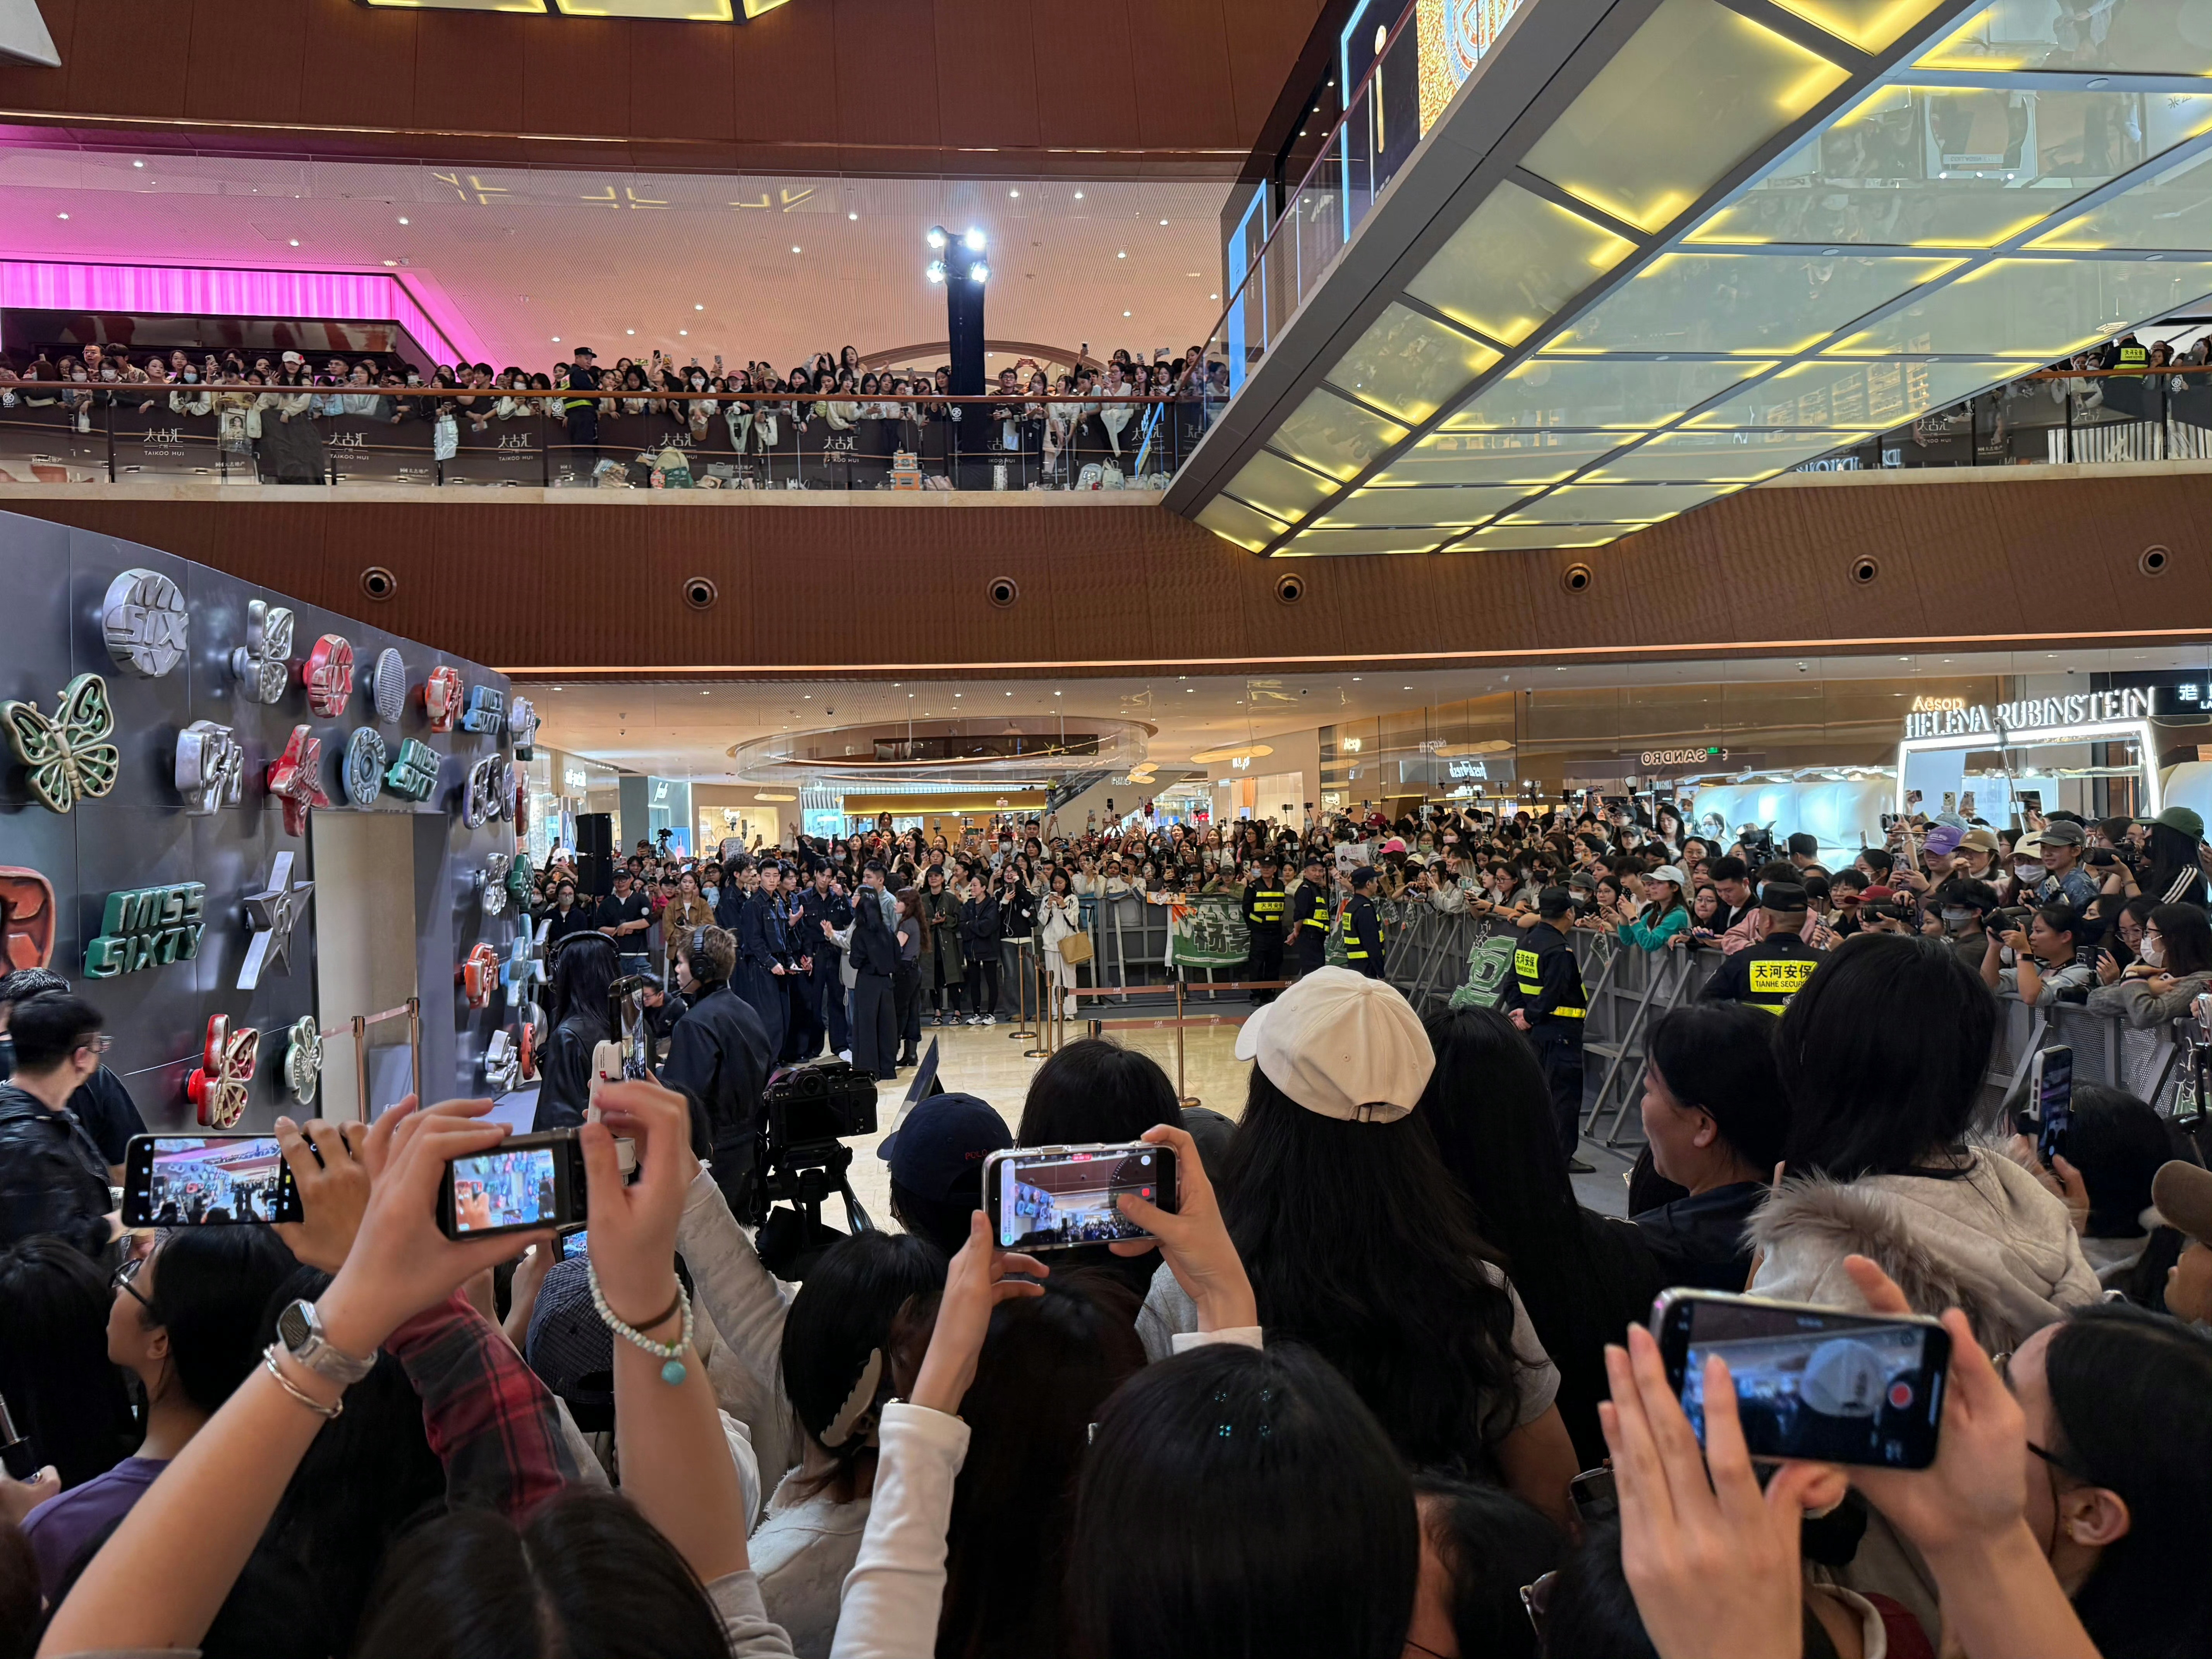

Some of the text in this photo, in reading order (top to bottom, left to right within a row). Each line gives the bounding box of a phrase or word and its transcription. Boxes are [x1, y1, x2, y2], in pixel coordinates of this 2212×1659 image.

[144, 428, 183, 443] 太古汇
[329, 432, 368, 447] 太古汇
[498, 433, 532, 448] 太古汇
[660, 433, 697, 447] 太古汇
[823, 436, 859, 450] 太古汇
[1905, 686, 2155, 739] HELENA RUBINSTEIN
[1912, 696, 1963, 714] Aesop
[404, 739, 442, 775] MISS
[392, 763, 438, 802] SIXTY
[118, 883, 206, 932] MISS
[91, 922, 206, 978] SIXTY
[1516, 953, 1535, 967] 天河安保
[1755, 965, 1812, 979] 天河安保
[965, 1149, 987, 1160] POLO
